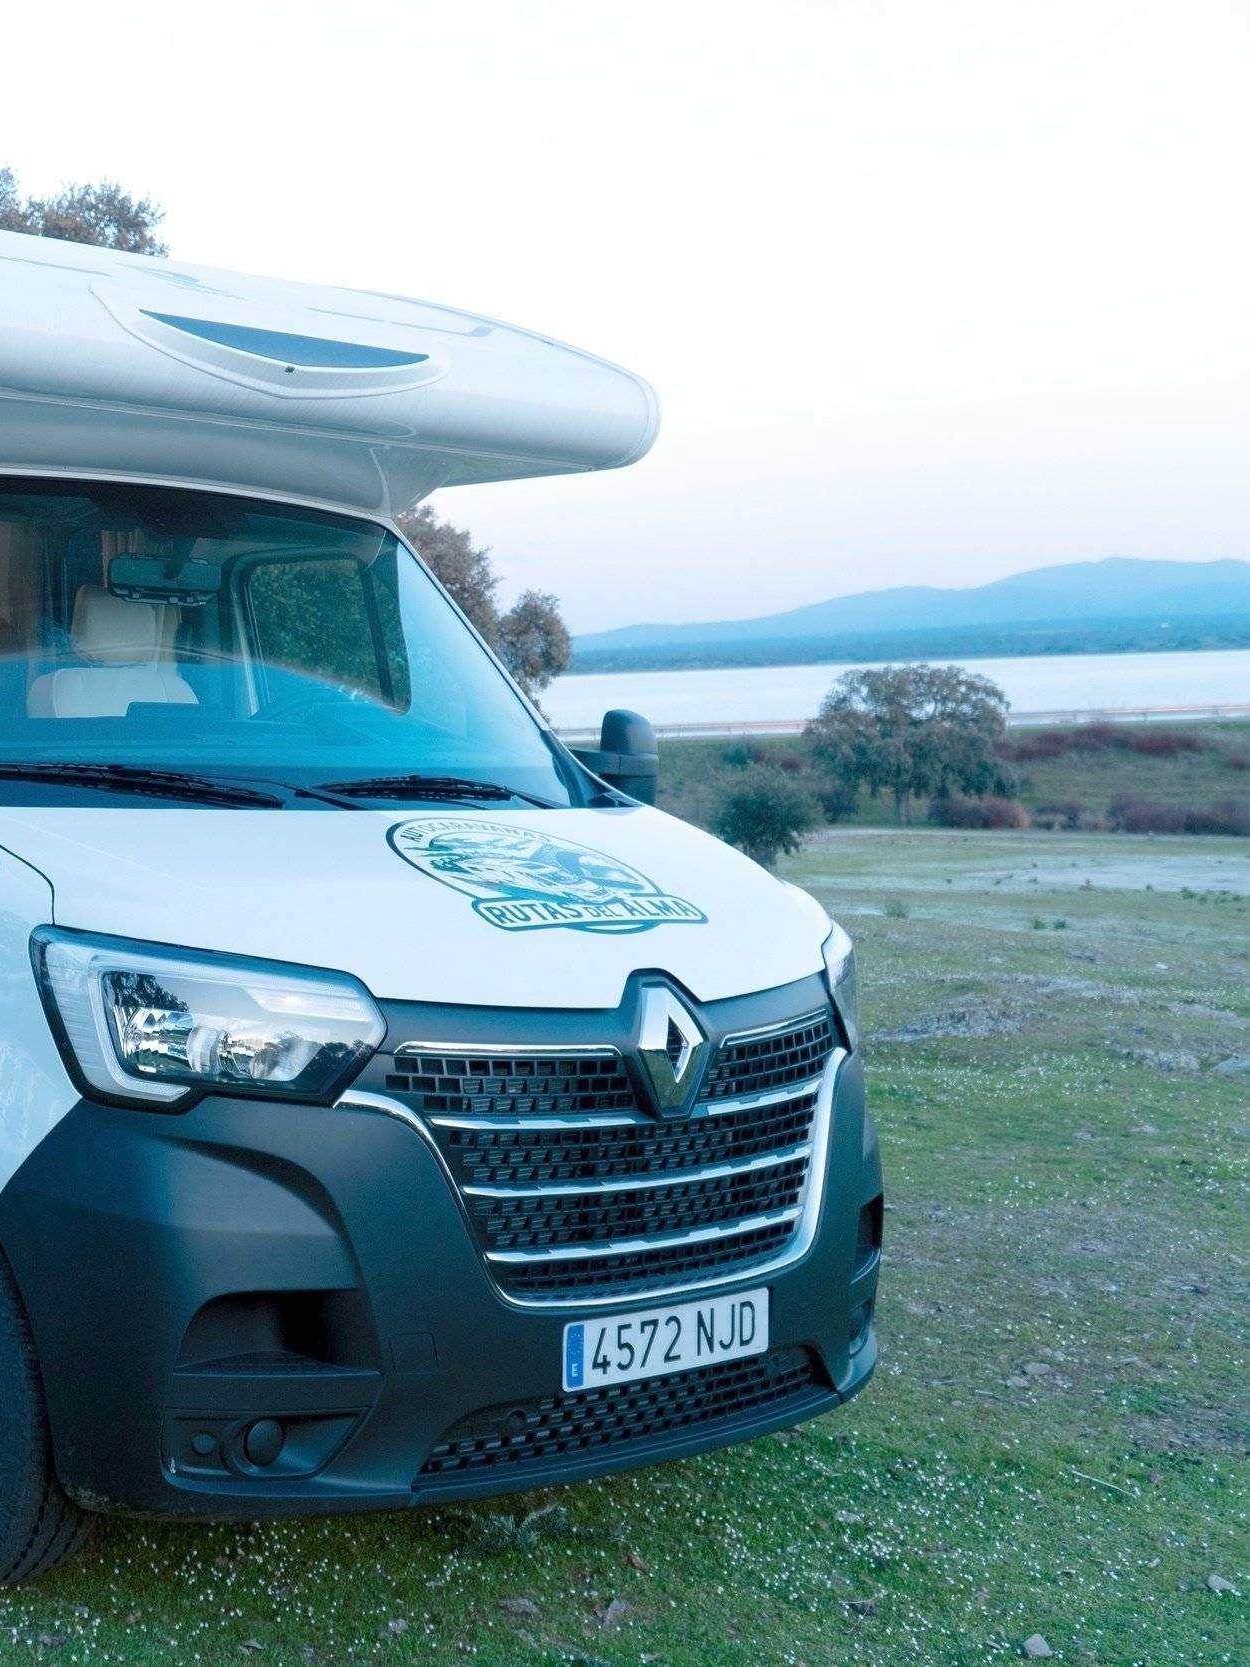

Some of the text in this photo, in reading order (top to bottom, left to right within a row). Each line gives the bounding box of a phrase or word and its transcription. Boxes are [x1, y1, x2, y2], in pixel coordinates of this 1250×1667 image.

[483, 899, 700, 924] RUTAS DEL ALMA
[591, 1300, 756, 1375] 4572 NJD
[571, 1363, 579, 1377] E
